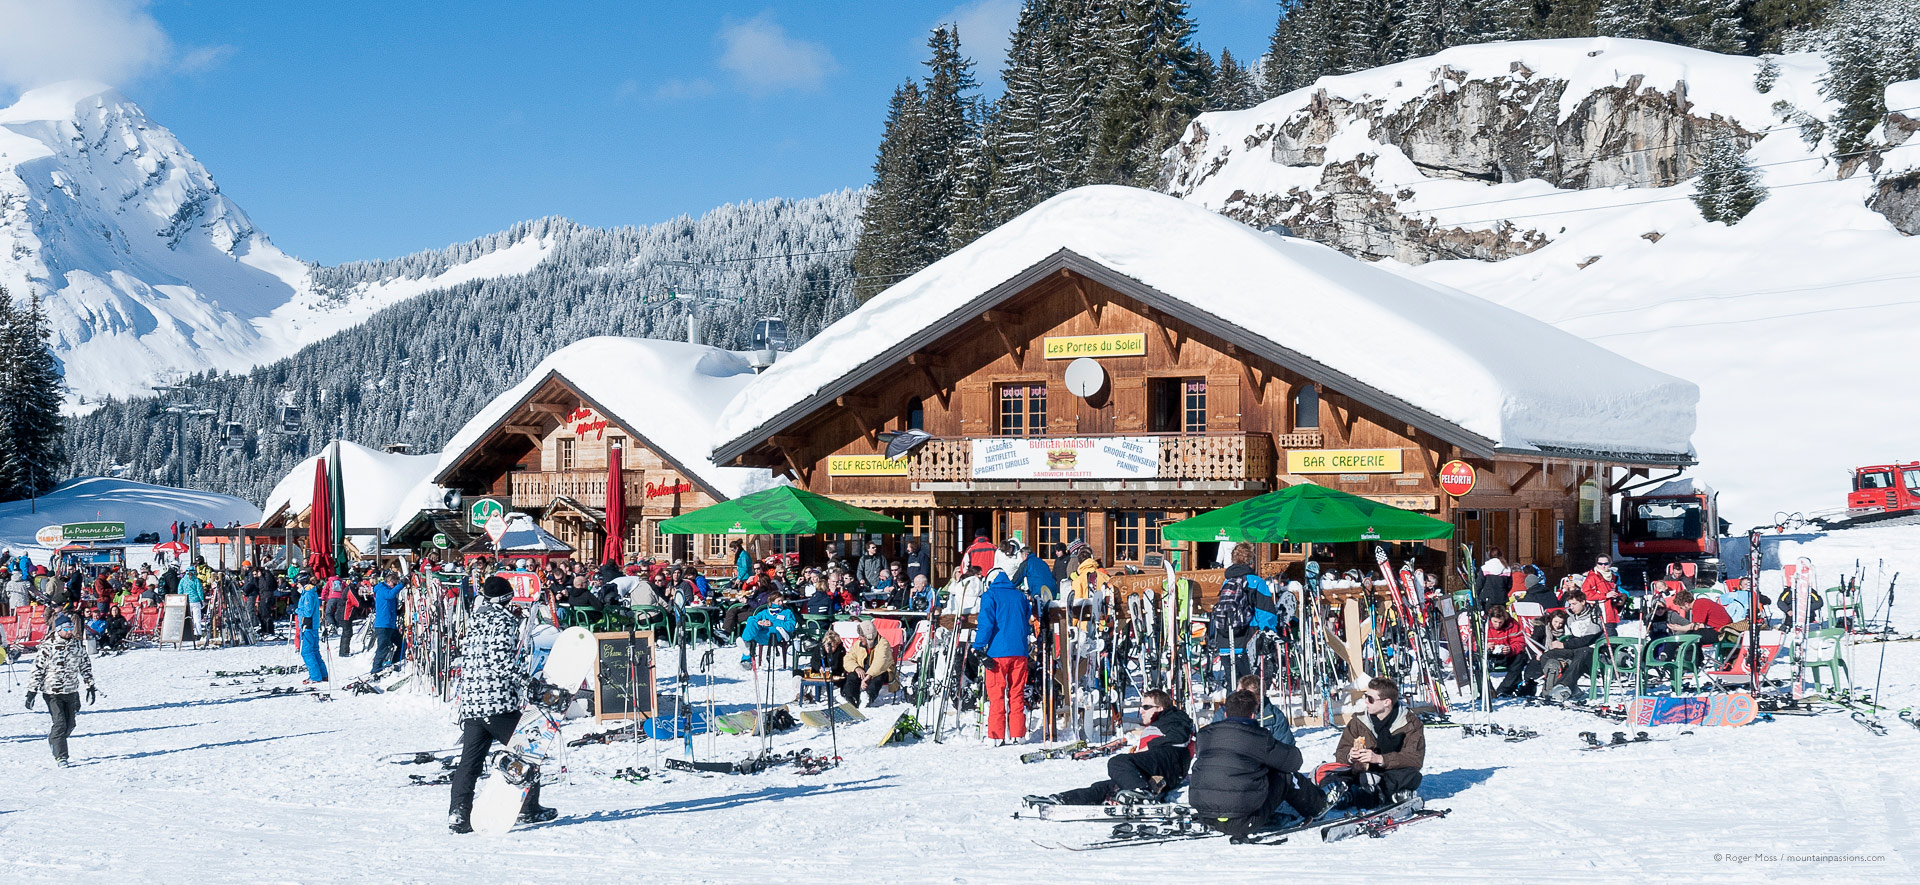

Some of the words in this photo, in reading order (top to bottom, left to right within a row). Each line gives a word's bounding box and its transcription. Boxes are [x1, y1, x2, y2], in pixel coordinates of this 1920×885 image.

[1048, 343, 1064, 353] Les
[1067, 341, 1098, 353] Portes
[1101, 340, 1112, 351] du
[1115, 339, 1142, 351] Soleil
[986, 441, 1013, 454] LASAGNES
[1029, 439, 1061, 449] BURGER
[1063, 439, 1095, 449] MAISON
[985, 450, 1017, 464] TARTIFLETTE
[1103, 445, 1157, 468] CROQUE-MONSIEUR
[1303, 456, 1326, 467] BAR
[1332, 455, 1385, 467] CREPERIE
[832, 460, 853, 471] SELF
[855, 460, 907, 470] RESTAURAN
[974, 462, 1004, 476] SPAGHETTI
[1005, 457, 1030, 470] GIROLLES
[1441, 473, 1472, 485] PELFORTH
[645, 477, 692, 501] Restaurant
[64, 527, 74, 535] La
[111, 525, 123, 533] Pin
[1132, 575, 1169, 591] PORT
[1200, 572, 1223, 585] SOL
